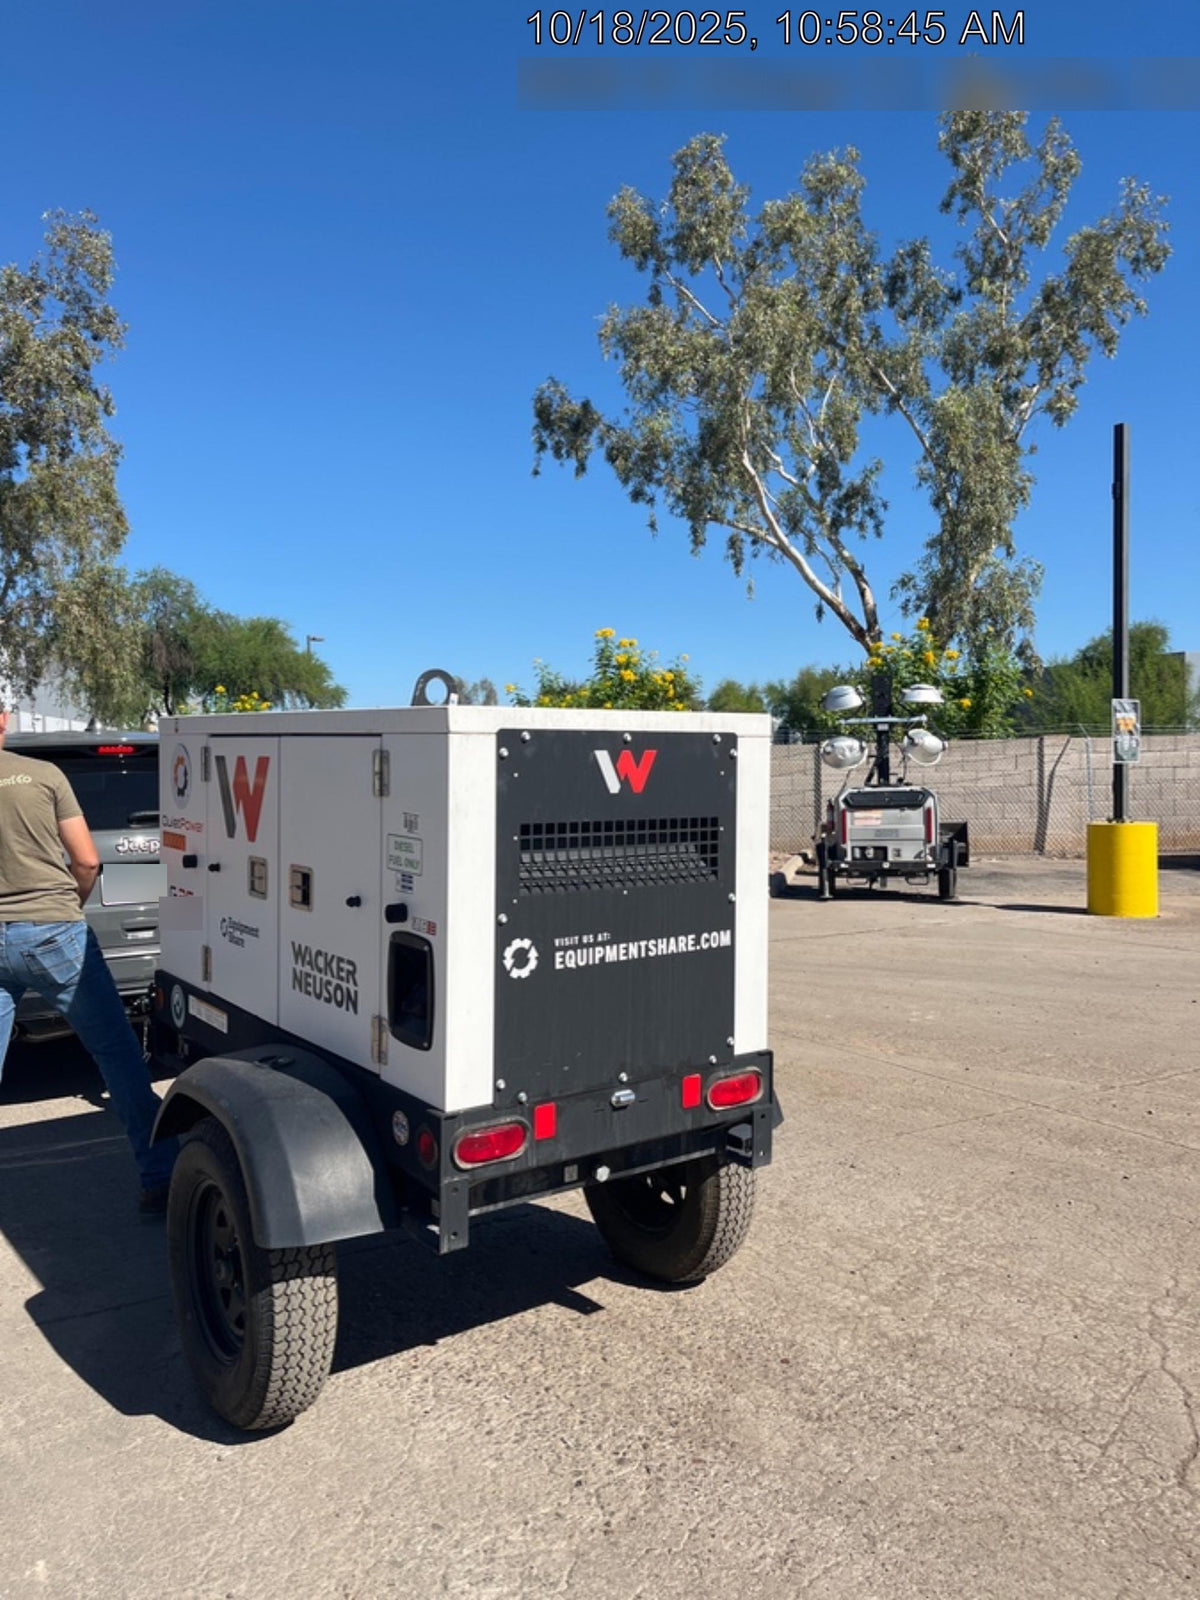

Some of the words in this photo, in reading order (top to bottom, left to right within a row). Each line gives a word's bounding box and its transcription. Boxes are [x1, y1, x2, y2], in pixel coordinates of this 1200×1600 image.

[115, 836, 160, 853] Jeep
[394, 839, 415, 854] DIESEL
[388, 854, 403, 867] FUEL
[403, 857, 420, 870] ONLY
[554, 935, 579, 947] VISIT
[582, 933, 595, 944] US
[597, 931, 611, 942] AT:
[554, 929, 732, 970] EQUIPMENTSHARE.COM
[291, 940, 358, 987] WACKER
[292, 966, 358, 1015] NEUSON
